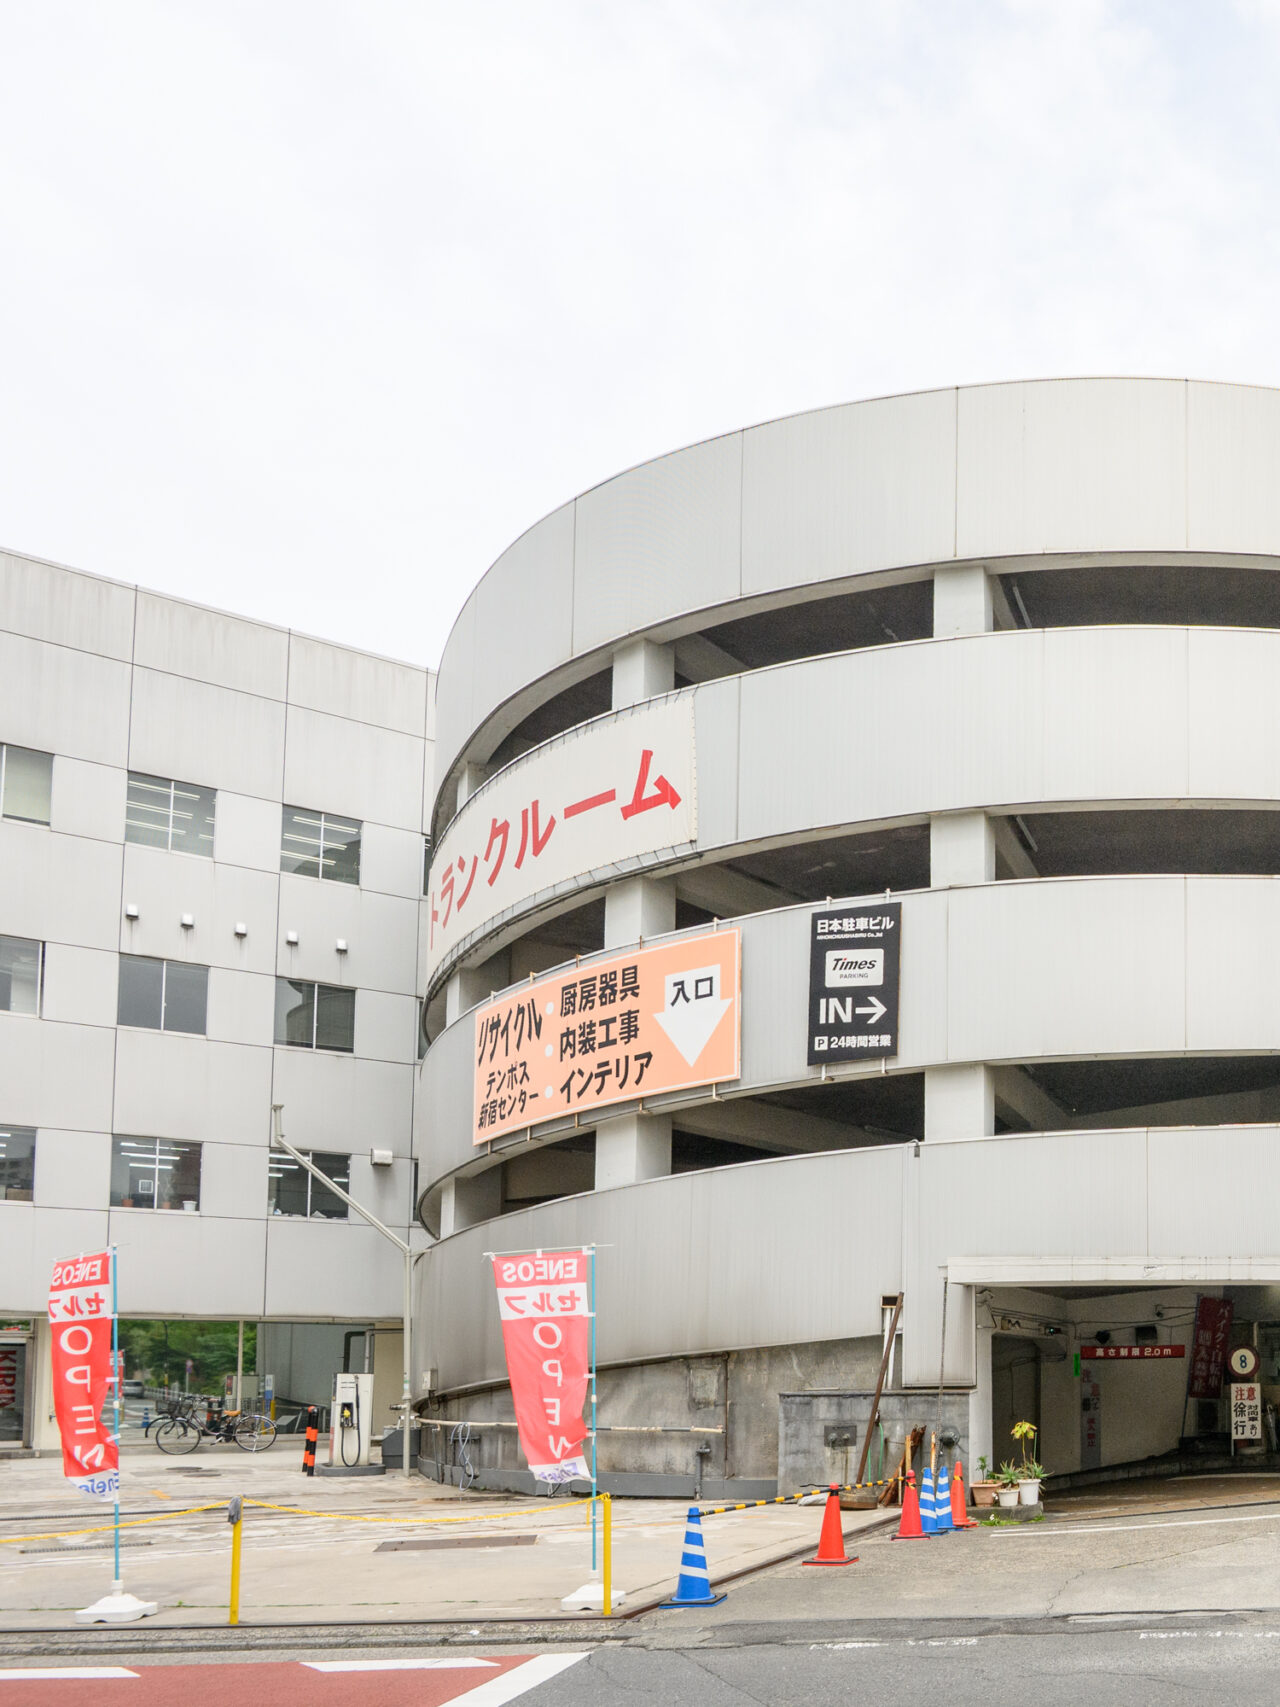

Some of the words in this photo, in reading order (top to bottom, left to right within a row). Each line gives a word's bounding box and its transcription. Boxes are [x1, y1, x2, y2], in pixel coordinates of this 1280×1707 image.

[429, 749, 682, 951] トランクルーム
[817, 916, 894, 933] 日本駐車ビル
[832, 957, 877, 971] Times
[559, 965, 641, 1019] 厨房器具
[670, 976, 714, 1008] 入口
[819, 997, 853, 1024] IN
[477, 998, 542, 1067] リサイクル
[559, 1007, 641, 1062] 内装工事
[830, 1035, 892, 1049] 24時間営業
[486, 1059, 531, 1100] テンポス
[559, 1051, 653, 1104] インテリア
[477, 1090, 540, 1132] 新宿センター
[1239, 1354, 1247, 1369] 8
[1235, 1386, 1257, 1401] 注意
[1233, 1402, 1247, 1436] 徐行
